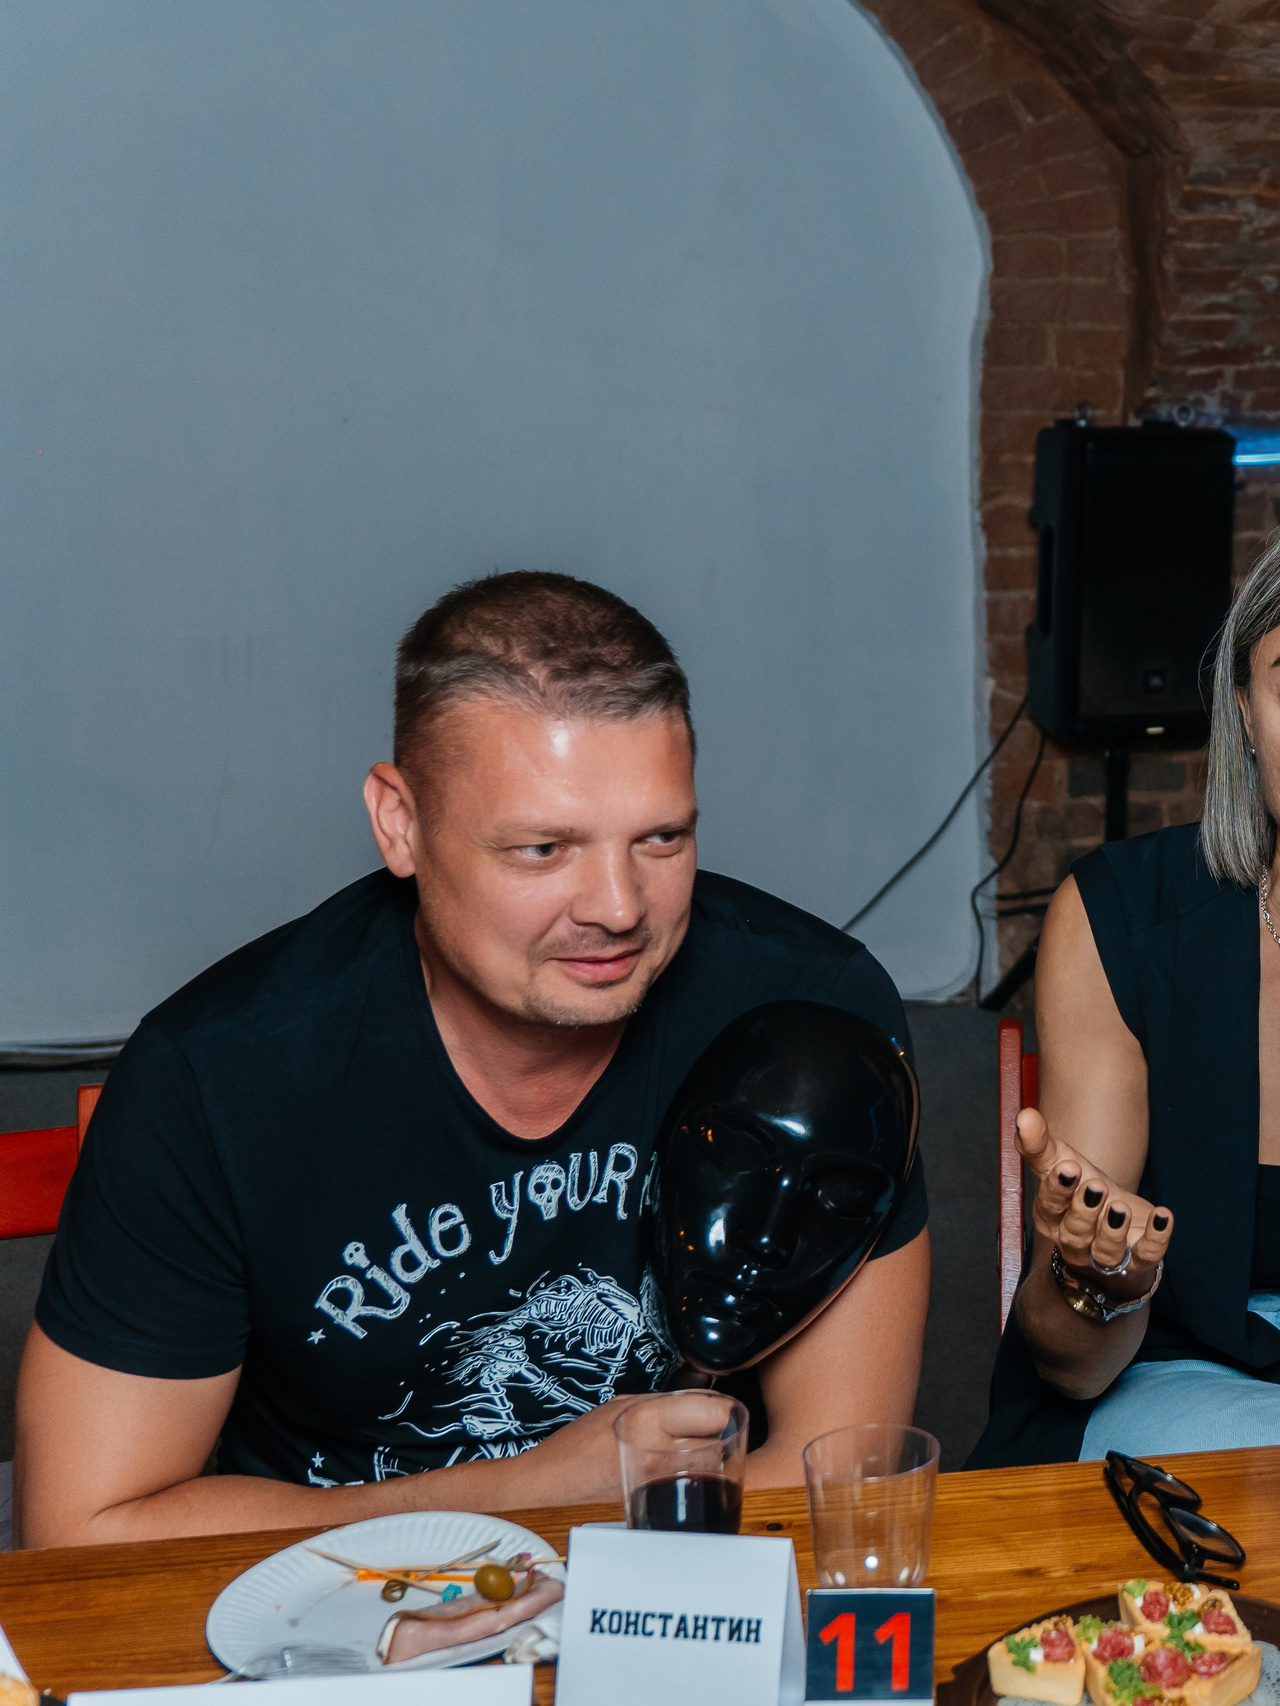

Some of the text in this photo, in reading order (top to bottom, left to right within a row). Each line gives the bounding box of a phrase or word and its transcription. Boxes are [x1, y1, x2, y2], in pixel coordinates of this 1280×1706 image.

[313, 1202, 473, 1340] Ride
[589, 1608, 763, 1643] КОНСТАНТИН
[818, 1611, 911, 1692] 11
